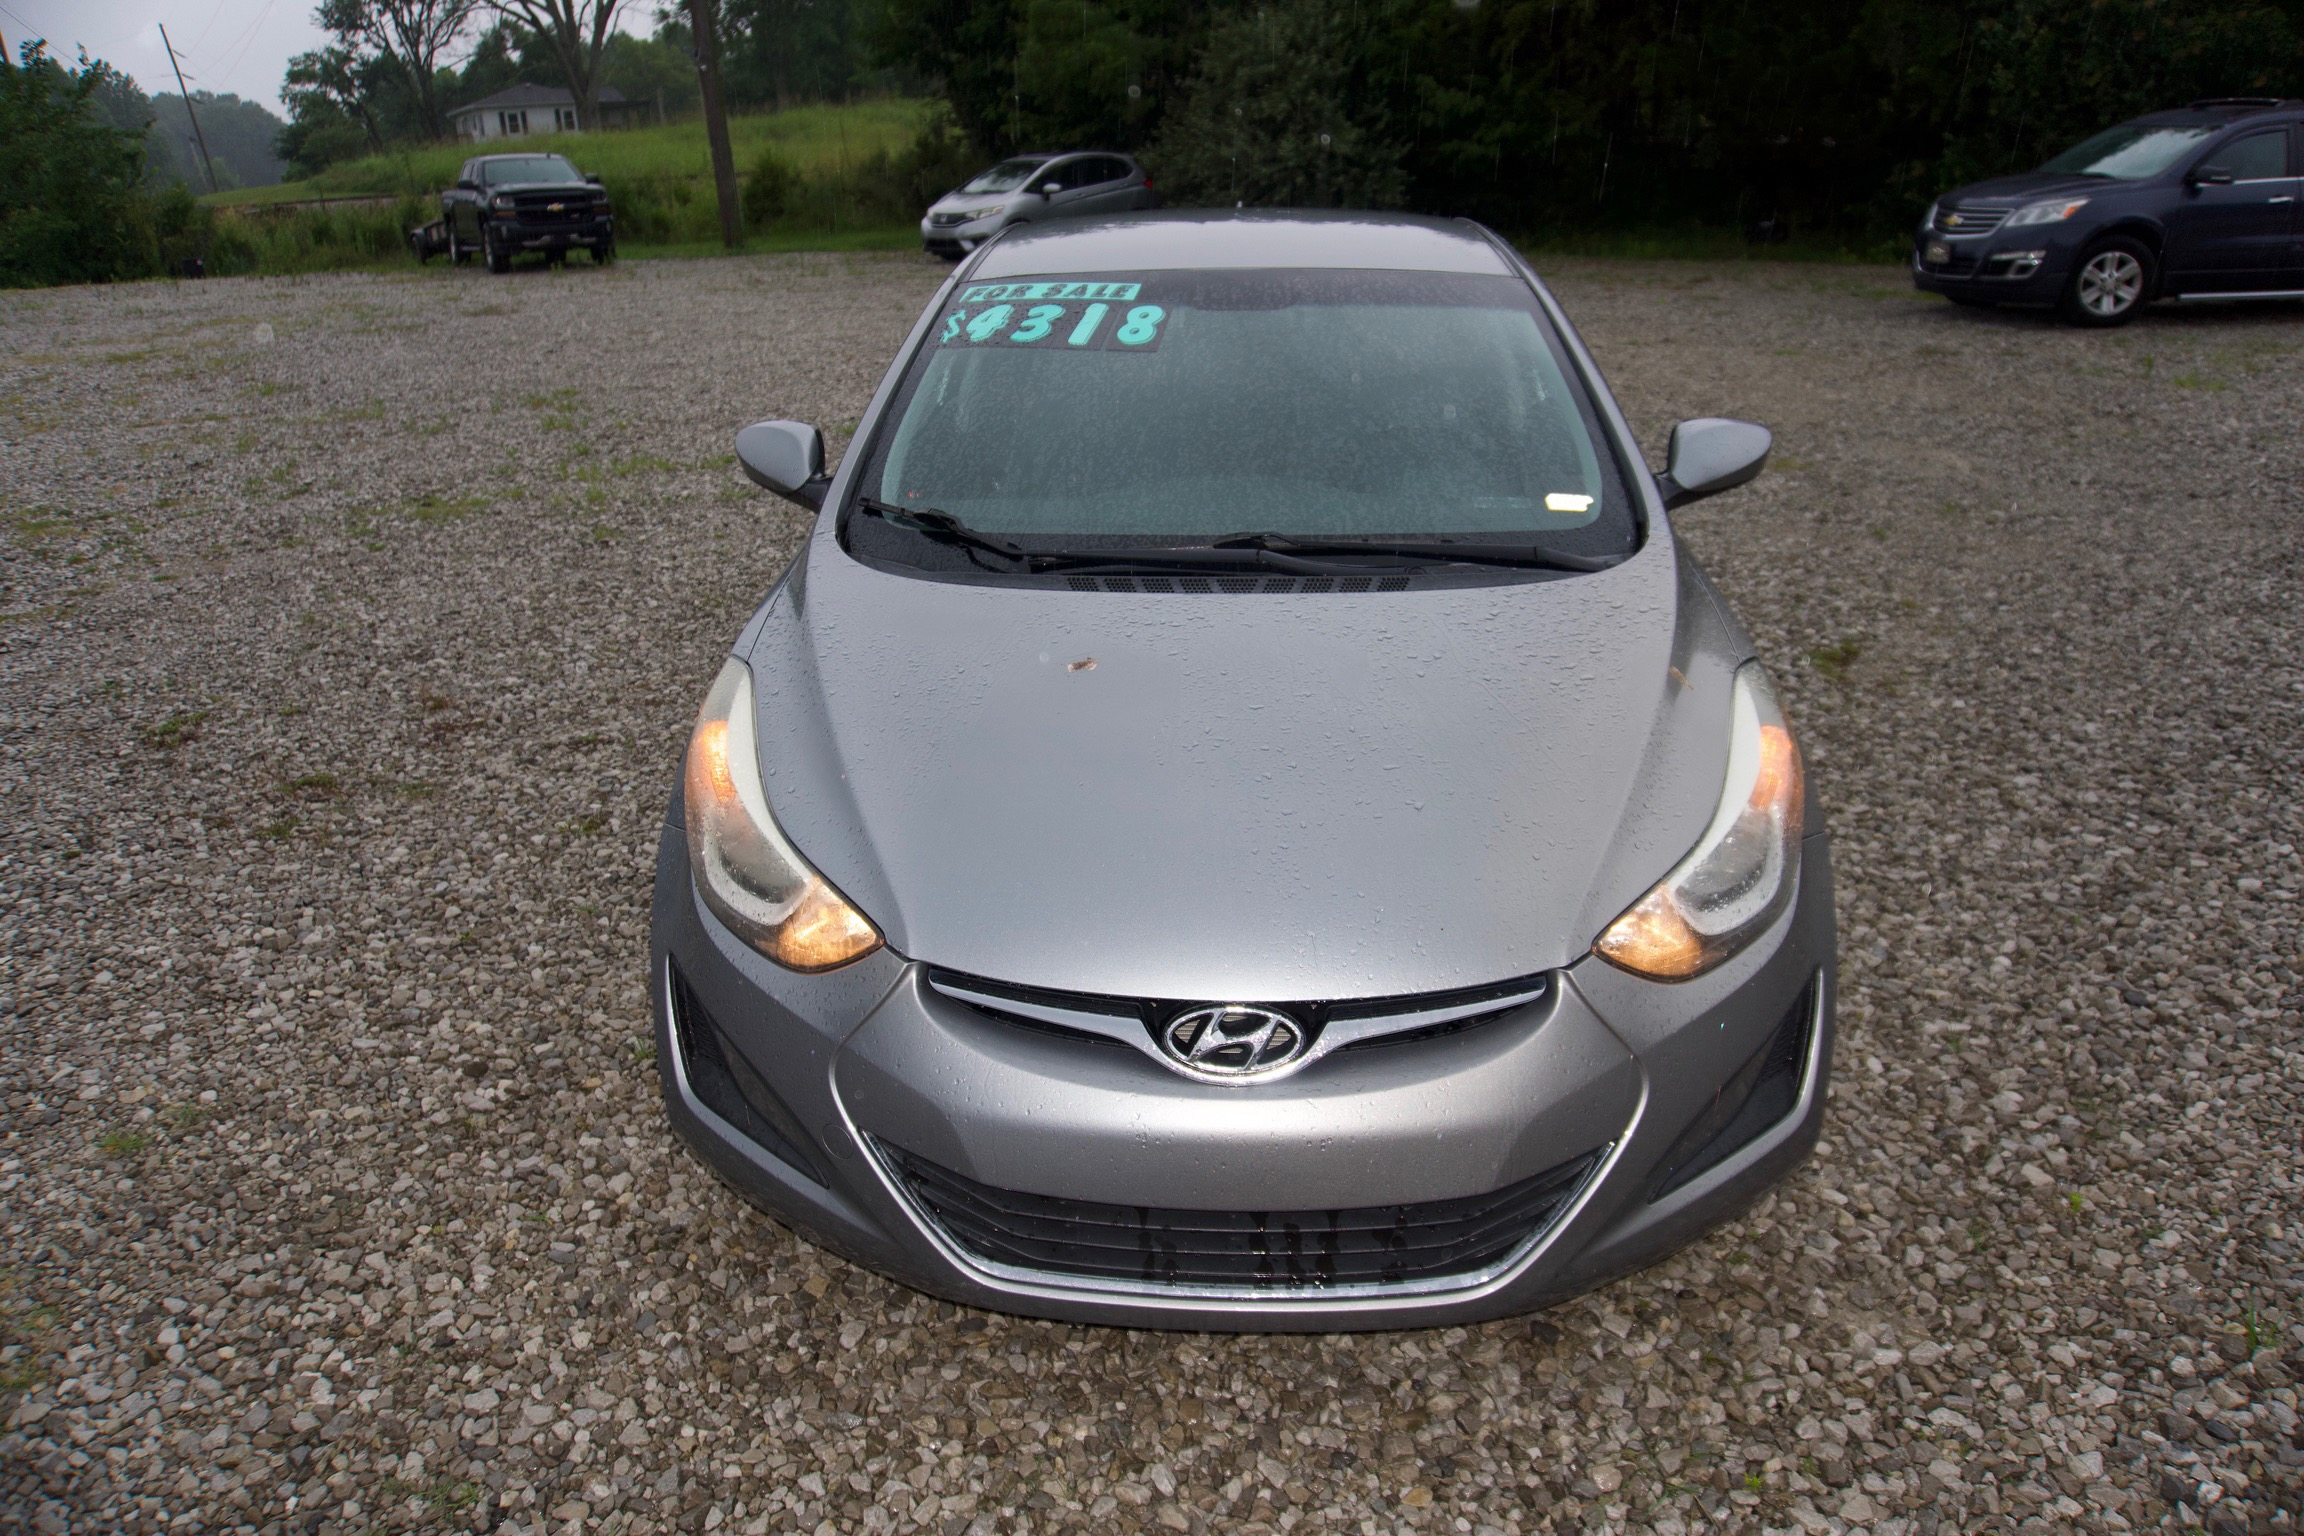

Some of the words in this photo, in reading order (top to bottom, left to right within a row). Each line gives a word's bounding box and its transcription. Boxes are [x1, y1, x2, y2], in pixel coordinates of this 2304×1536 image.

[966, 284, 1033, 301] FOR
[1042, 283, 1135, 299] SALE
[939, 303, 1165, 346] $4318
